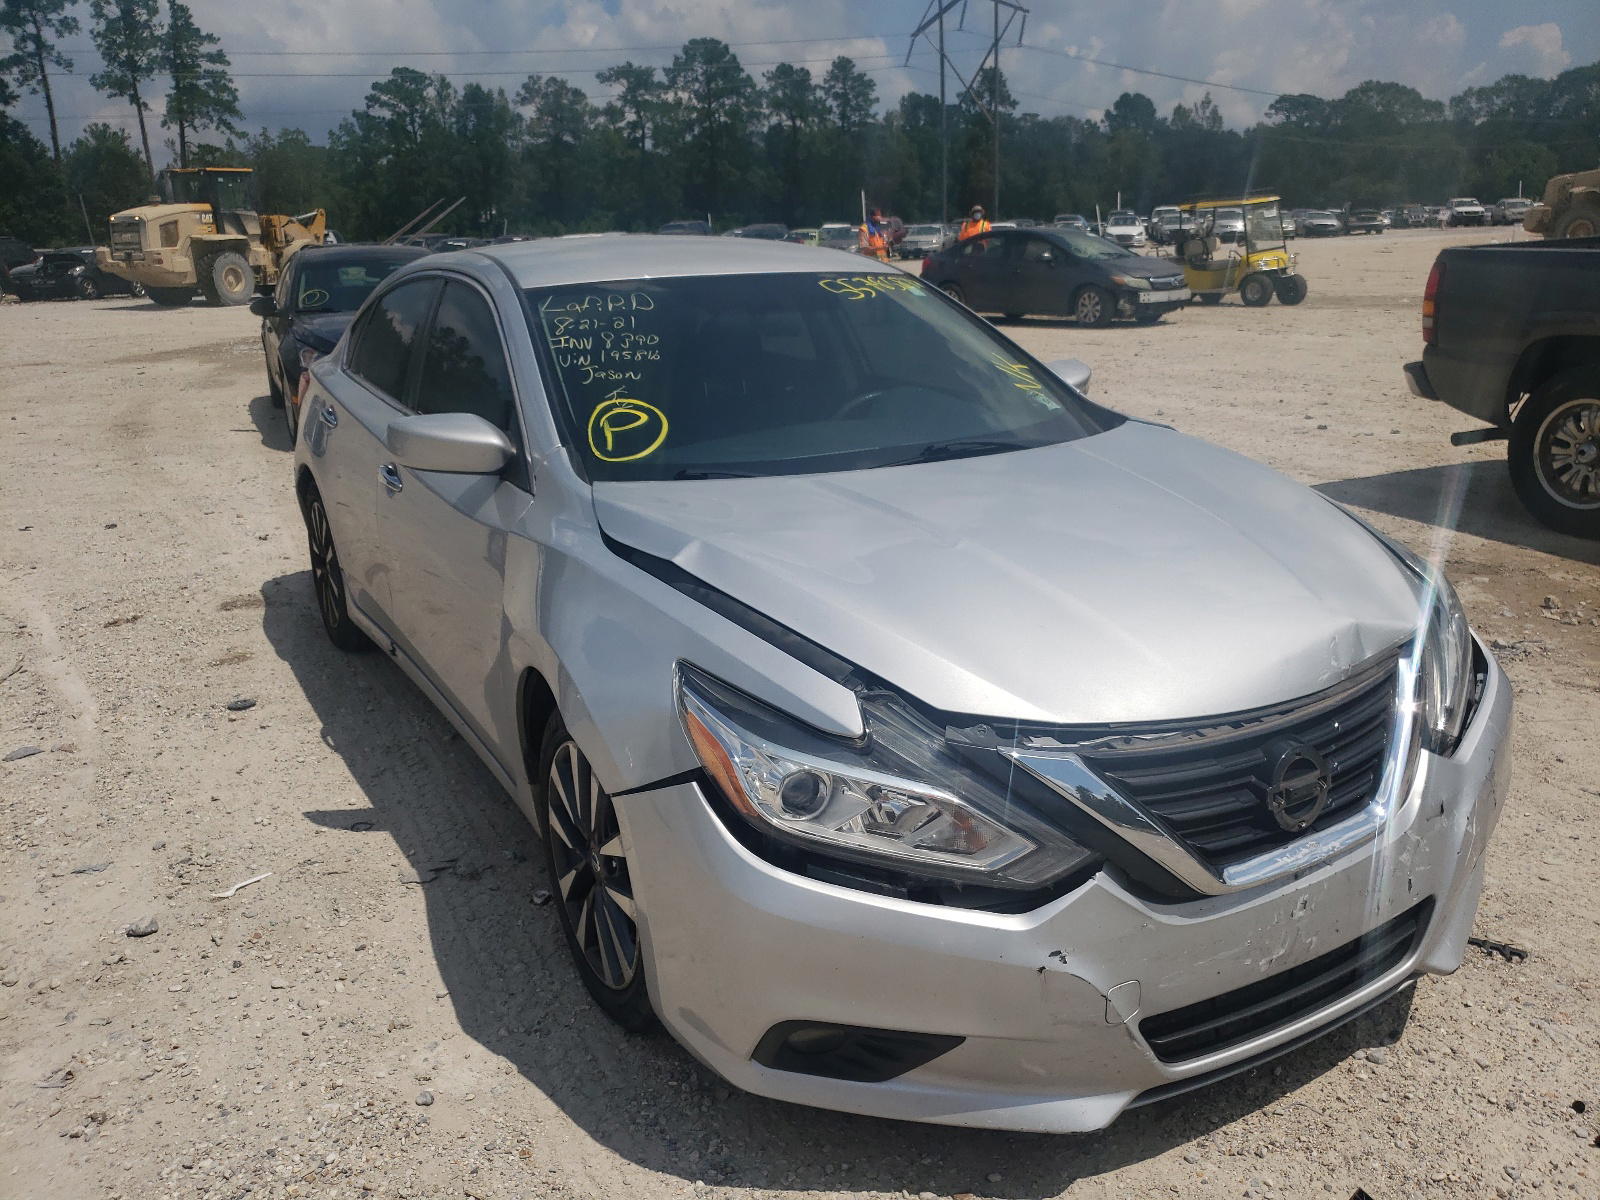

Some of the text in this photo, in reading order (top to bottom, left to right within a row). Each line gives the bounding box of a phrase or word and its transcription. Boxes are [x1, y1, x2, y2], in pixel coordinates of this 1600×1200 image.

[201, 213, 213, 224] CAT
[551, 336, 592, 350] INV
[580, 365, 642, 384] Jason
[600, 408, 649, 452] P
